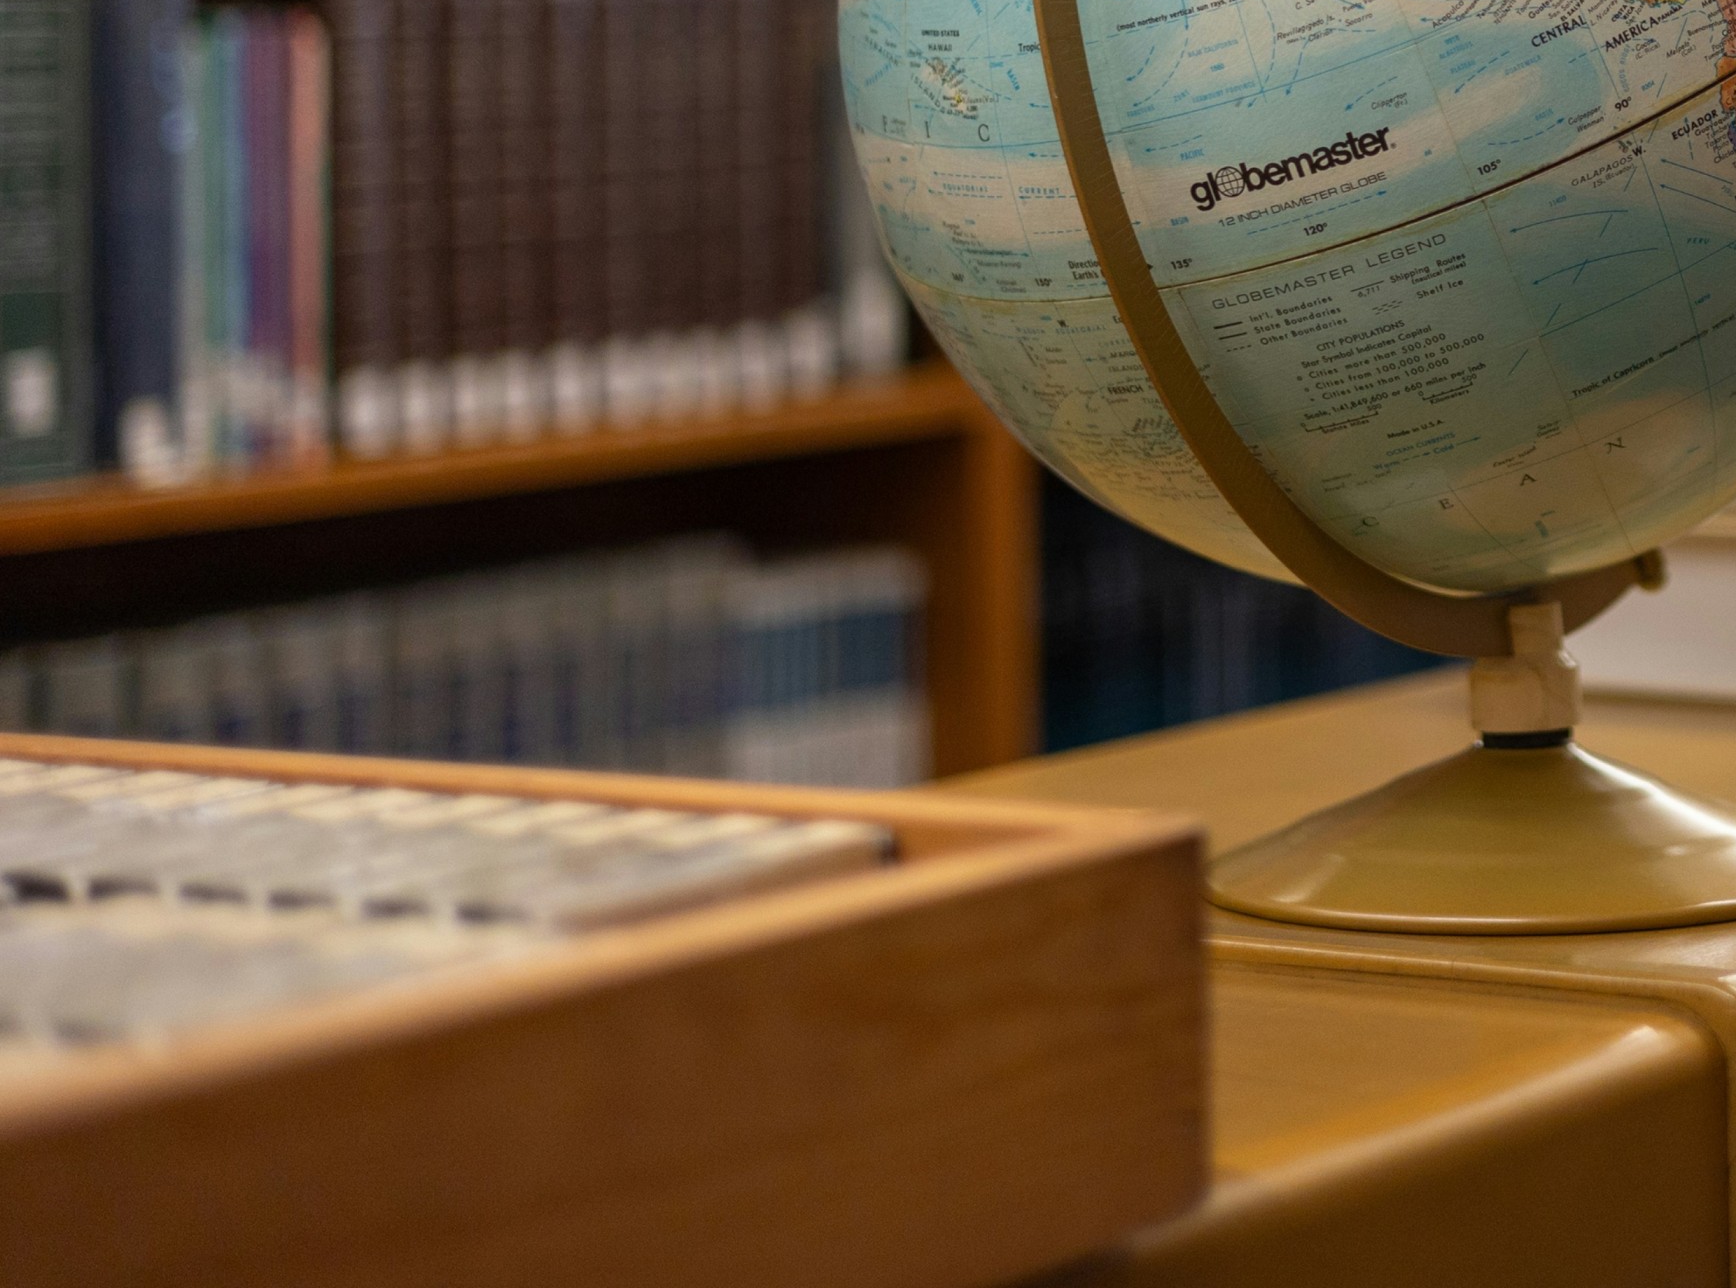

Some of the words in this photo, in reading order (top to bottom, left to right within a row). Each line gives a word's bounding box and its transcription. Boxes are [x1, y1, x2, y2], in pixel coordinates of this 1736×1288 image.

[1116, 19, 1135, 32] (most
[1137, 14, 1168, 27] northerly
[1169, 6, 1195, 19] vertical
[1197, 3, 1209, 12] sun
[1345, 13, 1374, 27] Socorro
[1432, 0, 1464, 29] Acapulco
[921, 29, 940, 37] UNITED
[940, 29, 960, 37] STATES
[1530, 14, 1588, 48] CENTRAL
[1604, 17, 1658, 52] AMERICA
[1614, 96, 1632, 112] 90°
[1671, 109, 1718, 141] ECUADOR
[1179, 148, 1205, 162] PACIFIC
[1632, 144, 1646, 158] W.
[1189, 126, 1391, 211] globemaster
[1477, 158, 1502, 176] 105°
[1570, 155, 1633, 187] GALAPAGOS
[1018, 186, 1059, 195] CURRENT
[1218, 216, 1237, 228] 12
[1237, 208, 1269, 223] INCH
[1270, 186, 1339, 216] DIAMETER
[1338, 171, 1388, 193] GLOBE
[1303, 222, 1328, 237] 120°
[1072, 270, 1099, 280] Earth's
[1170, 258, 1193, 270] 135°
[1211, 264, 1356, 310] GLOBEMASTER
[1364, 233, 1447, 269] LEGEND
[1389, 264, 1430, 284] Shipping
[1435, 253, 1466, 269] Routes
[1411, 269, 1443, 285] (nautical
[1443, 261, 1467, 274] miles)
[1416, 286, 1443, 301] Shelf
[1446, 279, 1464, 291] Ice
[1275, 295, 1333, 317] Boundaries
[1253, 318, 1282, 334] State
[1284, 307, 1342, 328] Boundaries
[1259, 328, 1288, 346] Other
[1290, 317, 1348, 338] Boundaries
[1301, 357, 1321, 369] Star
[1321, 346, 1354, 364] Symbol
[1353, 336, 1396, 356] Indicates
[1397, 324, 1432, 343] Capital
[1316, 338, 1340, 353] CITY
[1340, 319, 1405, 345] POPULATIONS
[1308, 366, 1340, 380] Cities
[1345, 356, 1371, 370] more
[1372, 346, 1398, 360] than
[1401, 333, 1446, 354] 500,000
[1315, 378, 1346, 392] Cities
[1350, 366, 1372, 381] from
[1375, 354, 1422, 374] 100,000
[1424, 350, 1437, 360] to
[1439, 333, 1485, 355] 500,000
[1107, 384, 1143, 394] FRENCH
[1322, 387, 1353, 401] Cities
[1356, 380, 1378, 392] less
[1380, 371, 1402, 384] than
[1404, 357, 1449, 378] 100,000
[1404, 383, 1423, 395] 660
[1425, 377, 1448, 390] miles
[1467, 363, 1486, 376] inch
[1571, 383, 1600, 401] Tropic
[1601, 374, 1613, 387] of
[1613, 357, 1655, 383] Capricorn
[1387, 428, 1411, 440] Made
[1421, 419, 1445, 430] U.S.A.
[1433, 444, 1454, 454] Cold
